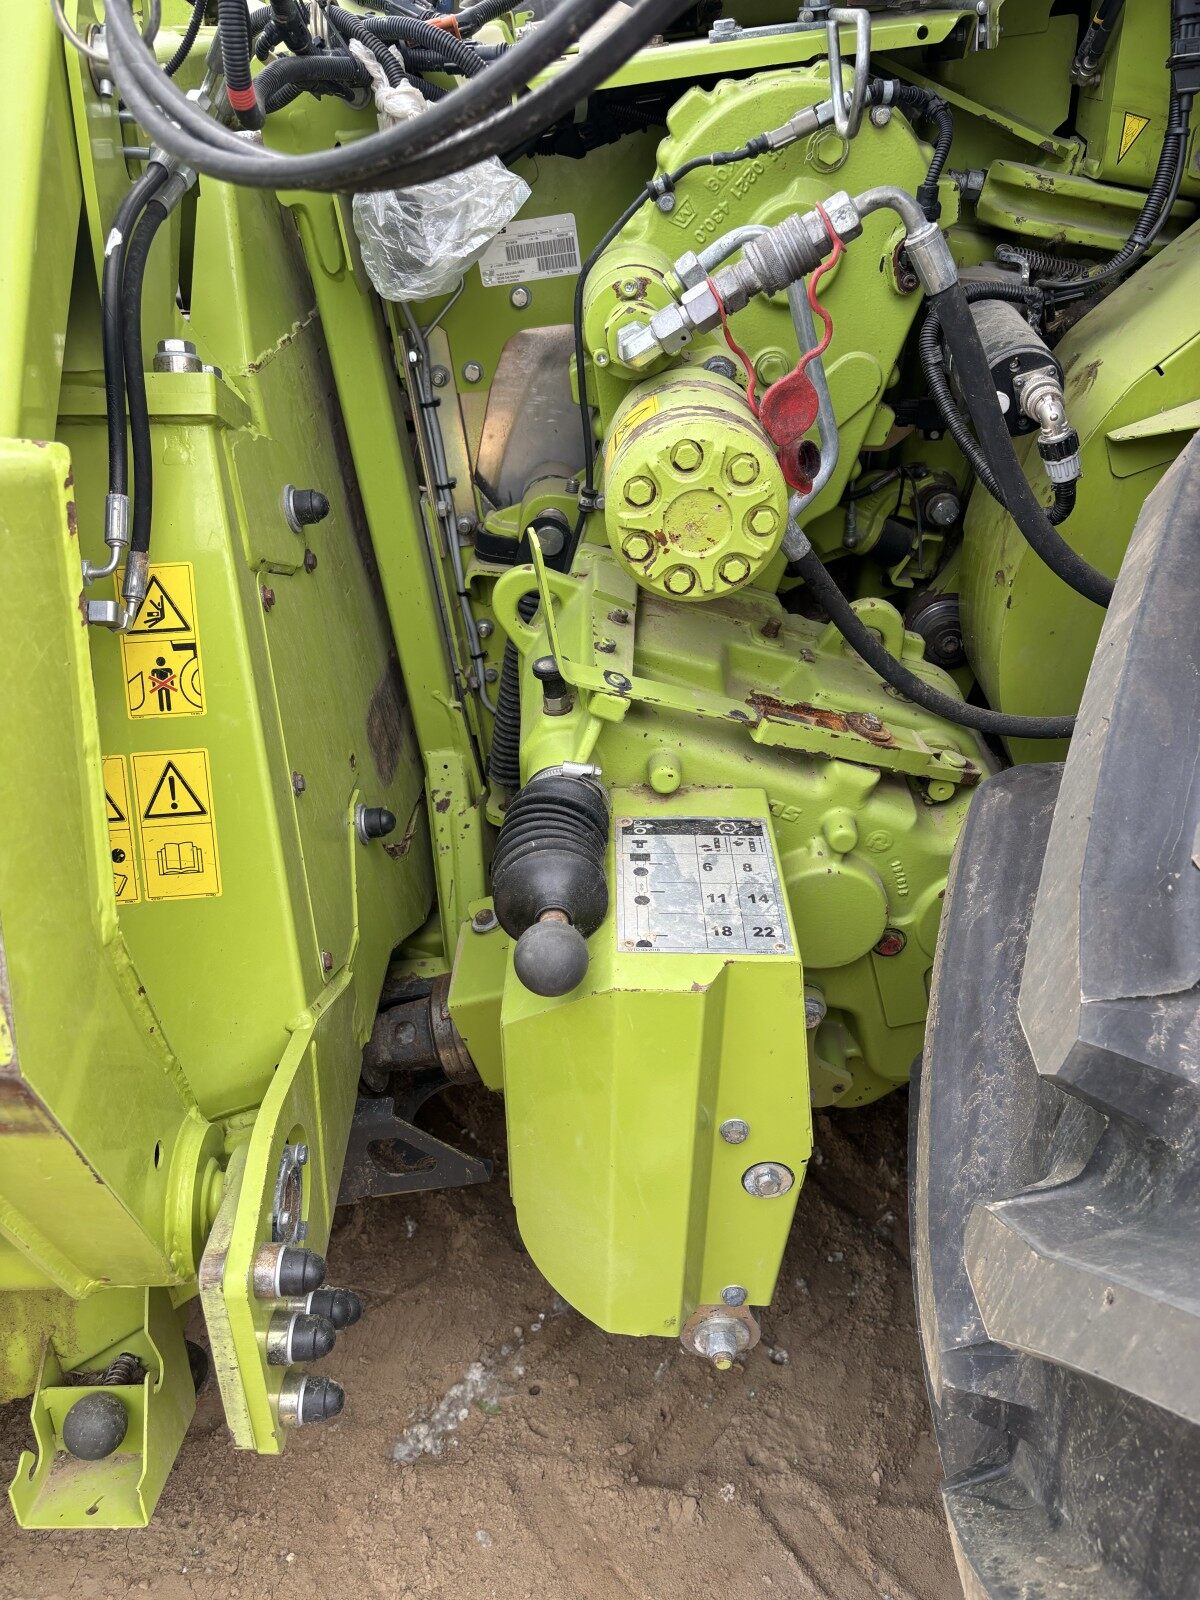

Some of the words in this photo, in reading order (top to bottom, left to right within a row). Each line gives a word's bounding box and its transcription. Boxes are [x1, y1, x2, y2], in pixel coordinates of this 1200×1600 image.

[730, 160, 765, 200] 0221
[702, 862, 713, 872] 6
[742, 863, 753, 872] 8
[706, 893, 726, 904] 11
[747, 893, 770, 904] 14
[711, 926, 733, 937] 18
[752, 926, 776, 938] 22
